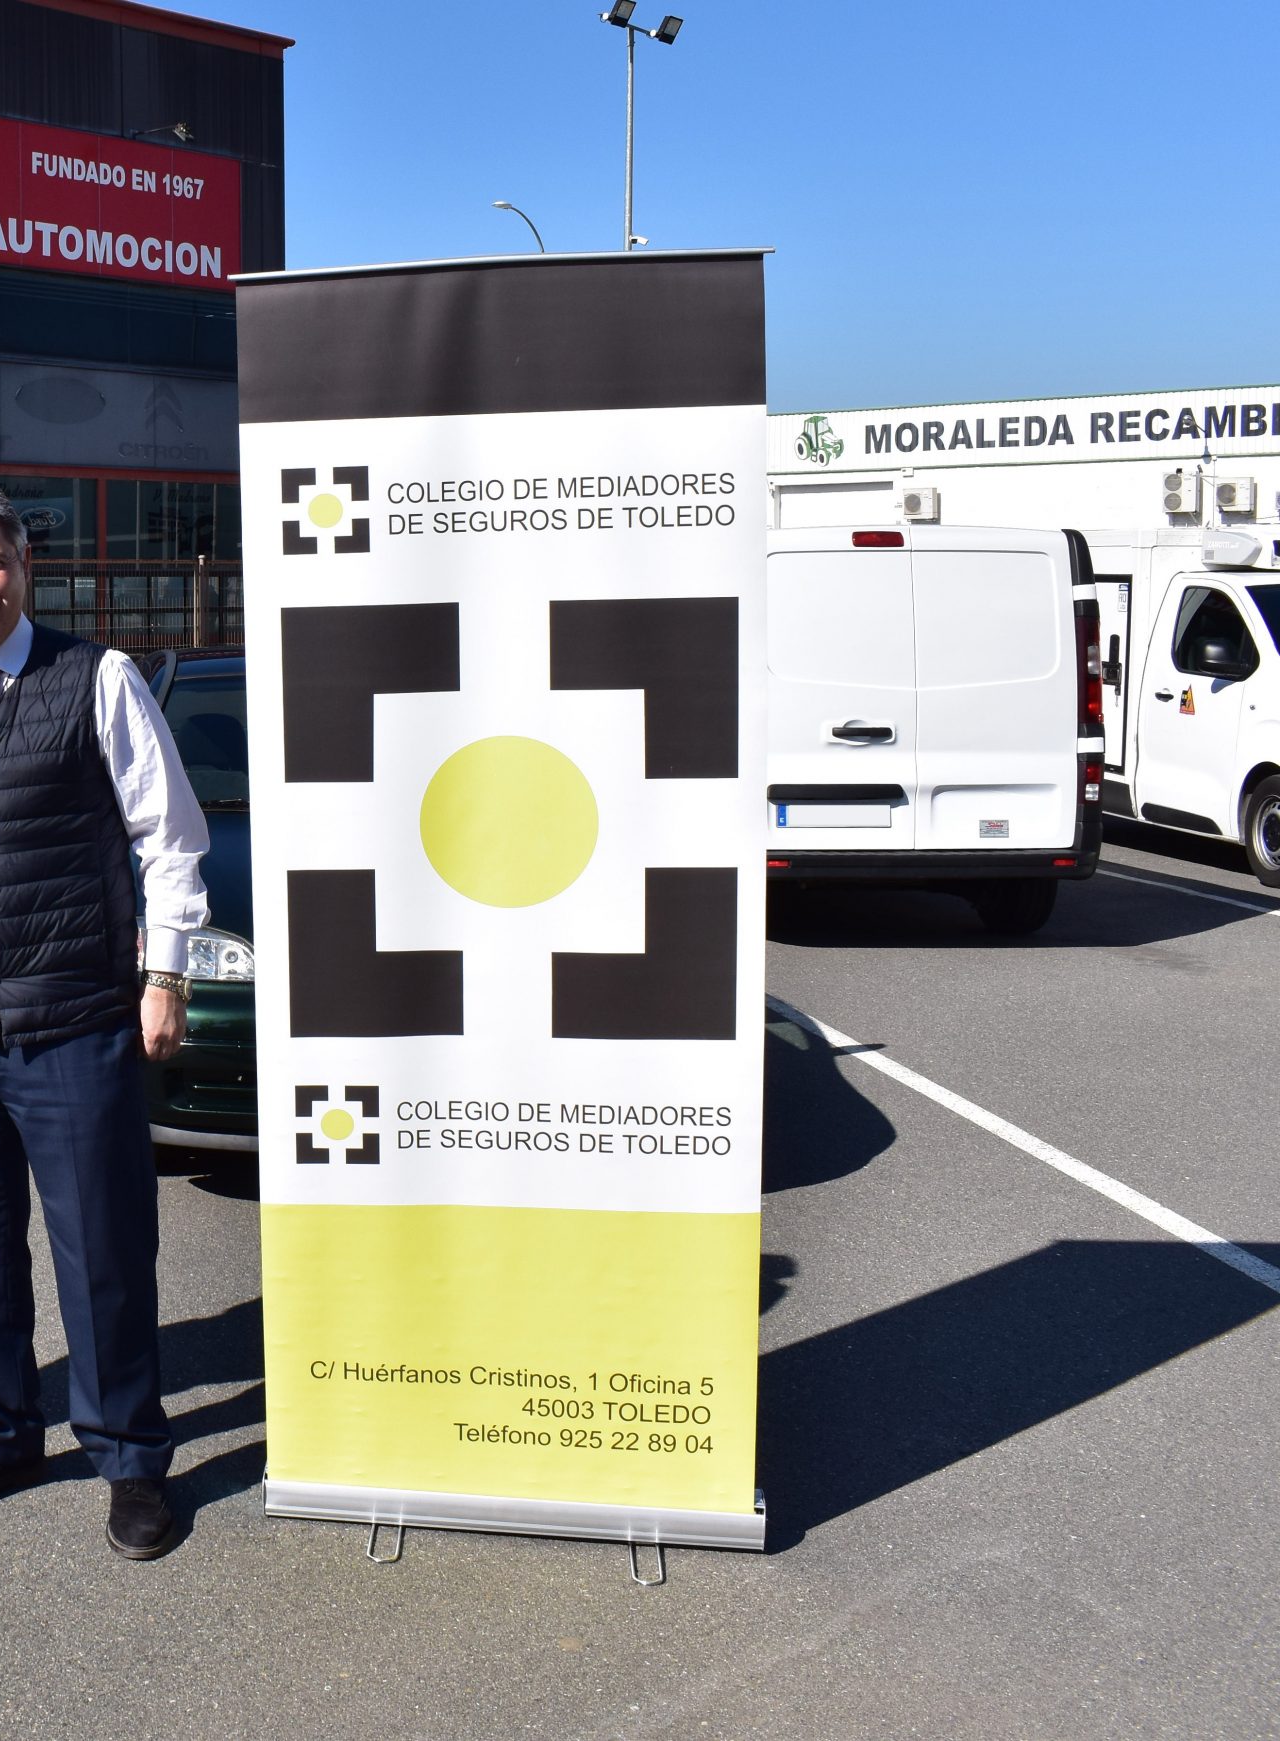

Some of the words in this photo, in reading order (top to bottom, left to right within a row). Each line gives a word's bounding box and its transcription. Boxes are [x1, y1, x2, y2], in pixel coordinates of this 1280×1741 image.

[31, 152, 126, 187] FUNDADO
[132, 168, 156, 193] EN
[162, 173, 204, 200] 1967
[865, 415, 1074, 454] MORALEDA
[387, 479, 504, 505] COLEGIO
[513, 478, 548, 500] DE
[557, 473, 735, 499] MEDIADORES
[388, 513, 424, 535] DE
[433, 508, 568, 534] SEGUROS
[577, 507, 614, 530] DE
[622, 504, 735, 529] TOLEDO
[397, 1100, 509, 1122] COLEGIO
[518, 1102, 551, 1123] DE
[561, 1104, 731, 1127] MEDIADORES
[398, 1129, 431, 1149] DE
[440, 1129, 570, 1152] SEGUROS
[579, 1133, 613, 1154] DE
[622, 1134, 731, 1156] TOLEDO
[310, 1360, 335, 1379] C/
[343, 1361, 461, 1384] Huérfanos
[469, 1366, 577, 1393] Cristinos,
[588, 1372, 597, 1391] 1
[609, 1372, 691, 1395] Oficina
[700, 1377, 714, 1396] 5
[521, 1398, 595, 1420] 45003
[602, 1401, 711, 1425] TOLEDO
[453, 1422, 551, 1446] Teléfono
[559, 1428, 603, 1449] 925
[611, 1431, 639, 1451] 22
[648, 1433, 677, 1453] 89
[685, 1434, 714, 1454] 04
